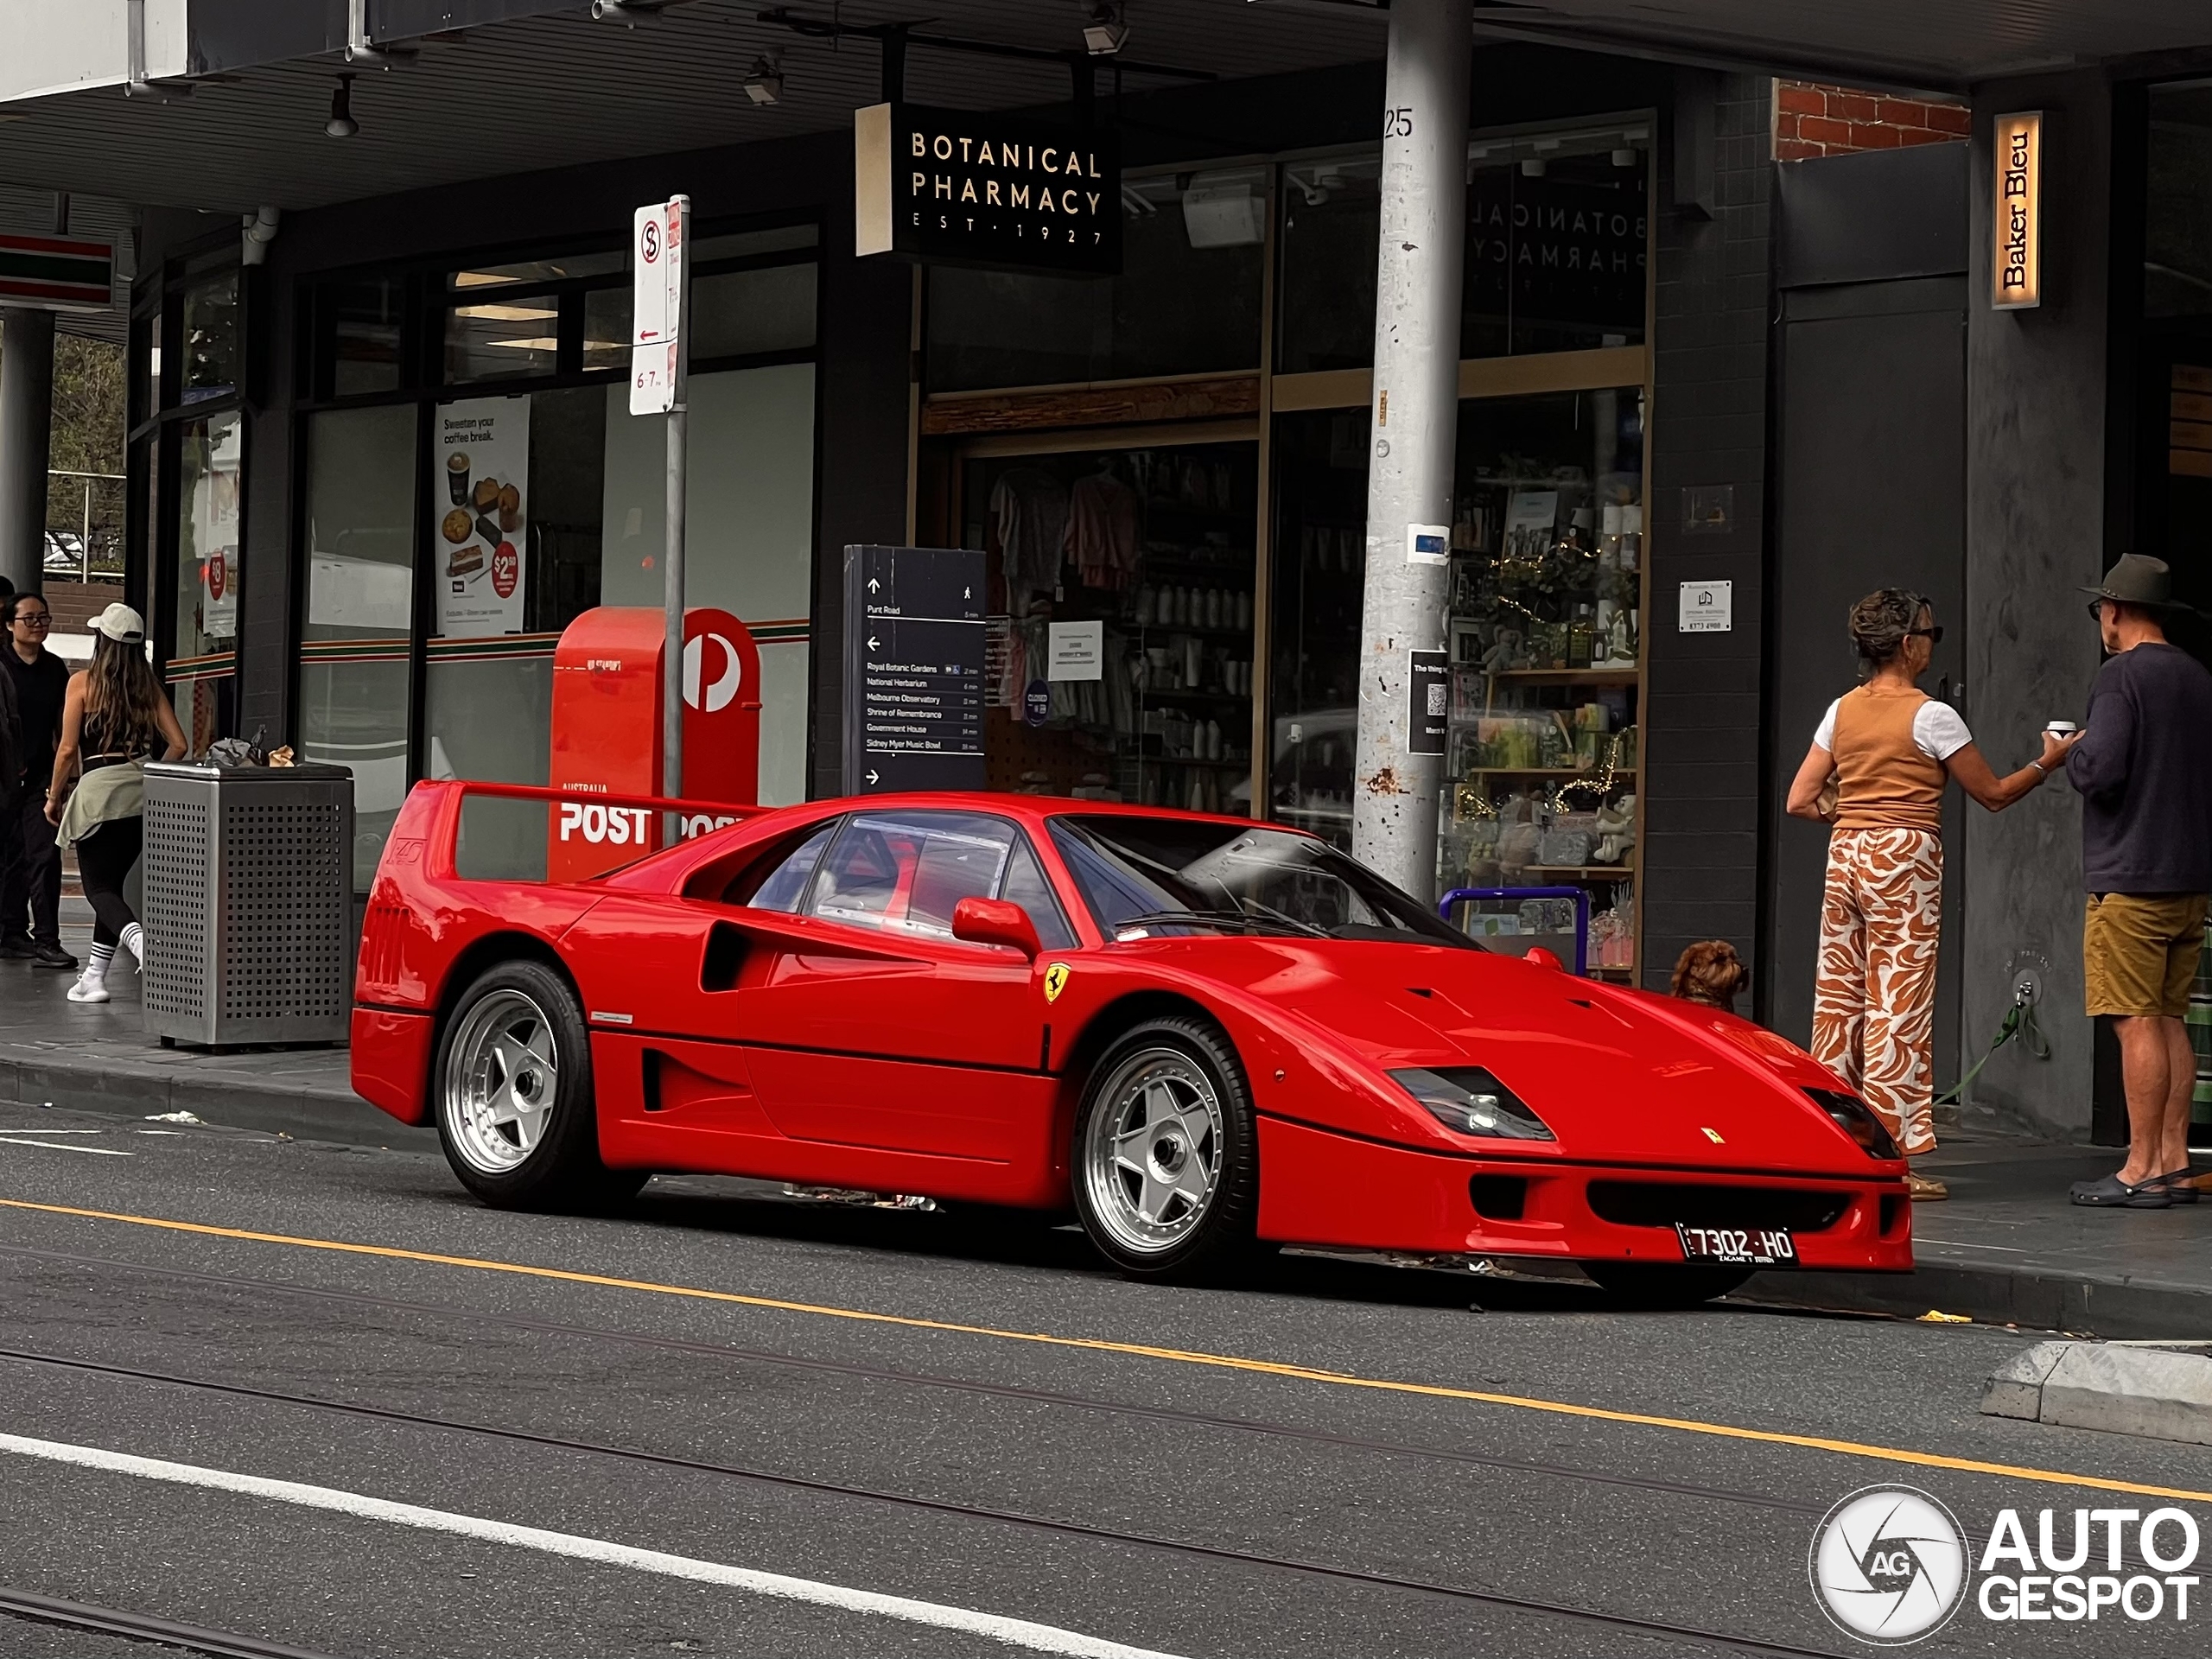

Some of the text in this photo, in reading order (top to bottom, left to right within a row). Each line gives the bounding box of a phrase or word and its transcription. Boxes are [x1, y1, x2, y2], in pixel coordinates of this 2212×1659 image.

[912, 132, 1101, 178] BOTANICAL
[912, 172, 1101, 215] PHARMACY
[2003, 131, 2028, 290] Baker Bleu
[444, 418, 494, 430] Sweeten your
[444, 430, 493, 444] coffee break.
[883, 606, 900, 614] Road
[867, 662, 885, 672] Royal
[886, 663, 910, 672] Botanic
[910, 664, 938, 673] Gardens
[893, 679, 928, 688] Herbarium
[867, 693, 900, 702] Melbourne
[900, 694, 941, 705] Observatory
[867, 708, 887, 716] Shrine
[897, 709, 942, 719] Remembrance
[867, 723, 906, 733] Government
[906, 725, 927, 734] House
[867, 739, 888, 748] Sidney
[888, 740, 905, 749] Myer
[906, 741, 925, 749] Music
[925, 741, 942, 750] Bowl
[561, 802, 652, 845] POST
